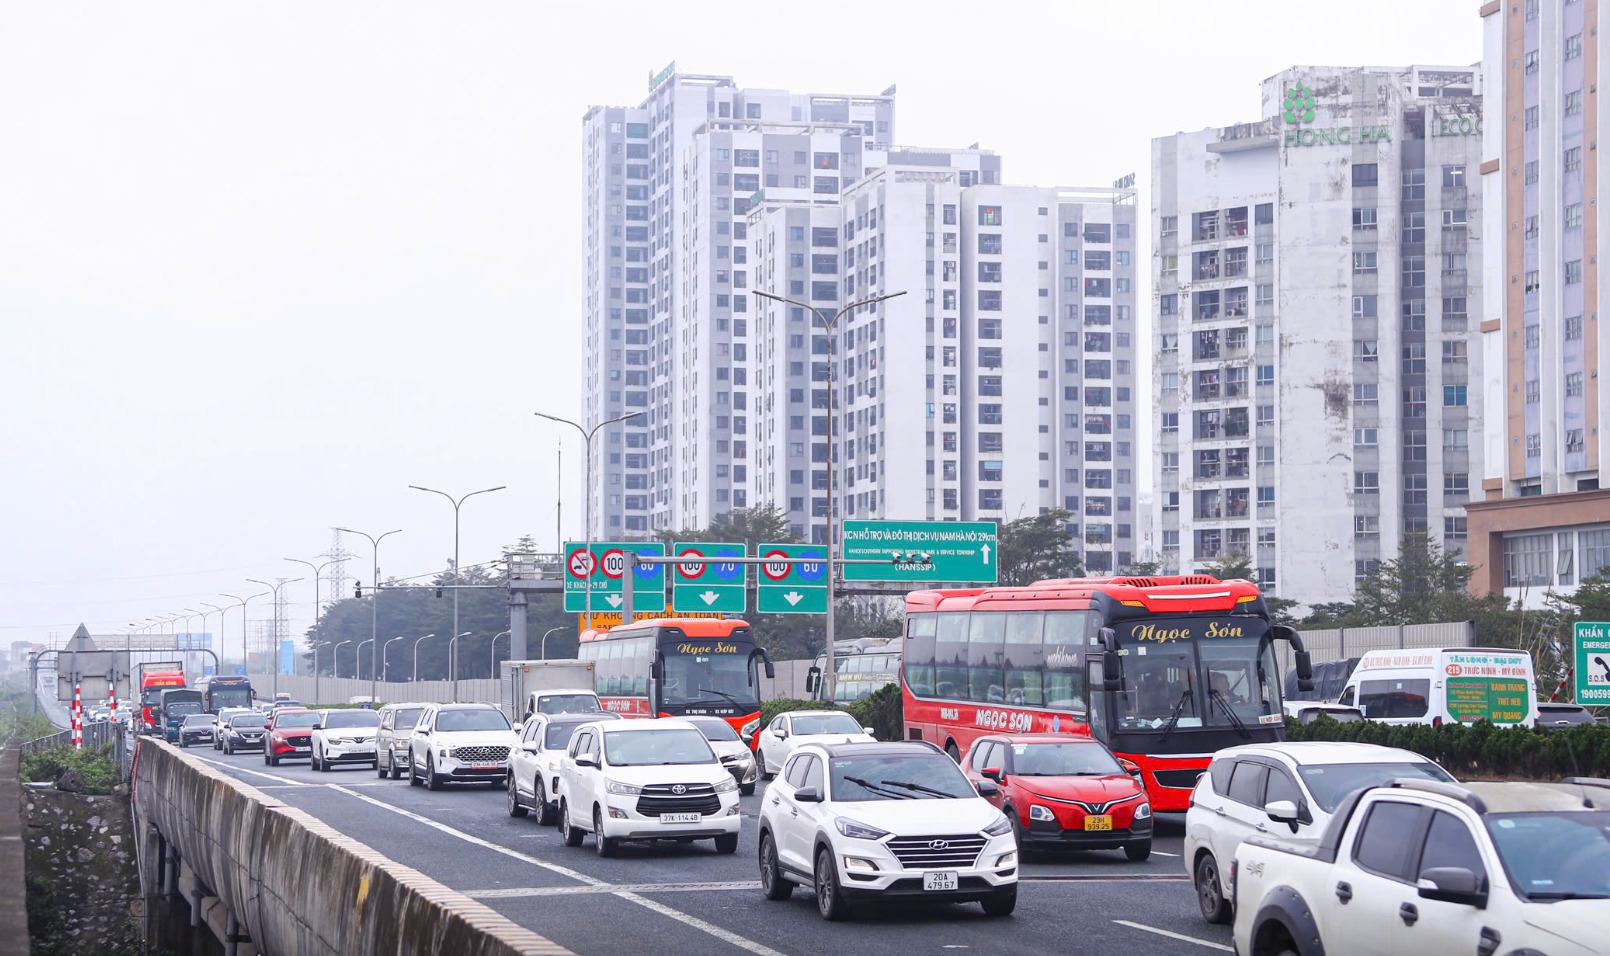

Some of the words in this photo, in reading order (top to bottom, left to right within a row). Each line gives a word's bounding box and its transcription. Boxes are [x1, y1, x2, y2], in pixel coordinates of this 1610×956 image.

[1440, 118, 1472, 136] ECO
[844, 531, 858, 539] KCN
[883, 528, 892, 540] VÀ
[892, 529, 903, 540] ĐÔ
[903, 531, 912, 542] THỊ
[913, 531, 929, 542] DỊCH
[930, 532, 939, 542] VỤ
[940, 532, 955, 541] NAM
[956, 530, 965, 541] HÀ
[966, 530, 977, 542] NỘI
[1132, 624, 1190, 644] Ngọc
[1205, 622, 1244, 638] Sơn
[1579, 624, 1603, 638] KHẨN
[677, 643, 711, 655] Ngọc
[714, 642, 738, 653] Sơn
[1447, 665, 1460, 674] 215
[976, 709, 1008, 730] NGỌC
[1009, 712, 1032, 732] SƠN
[928, 881, 954, 889] 479.67
